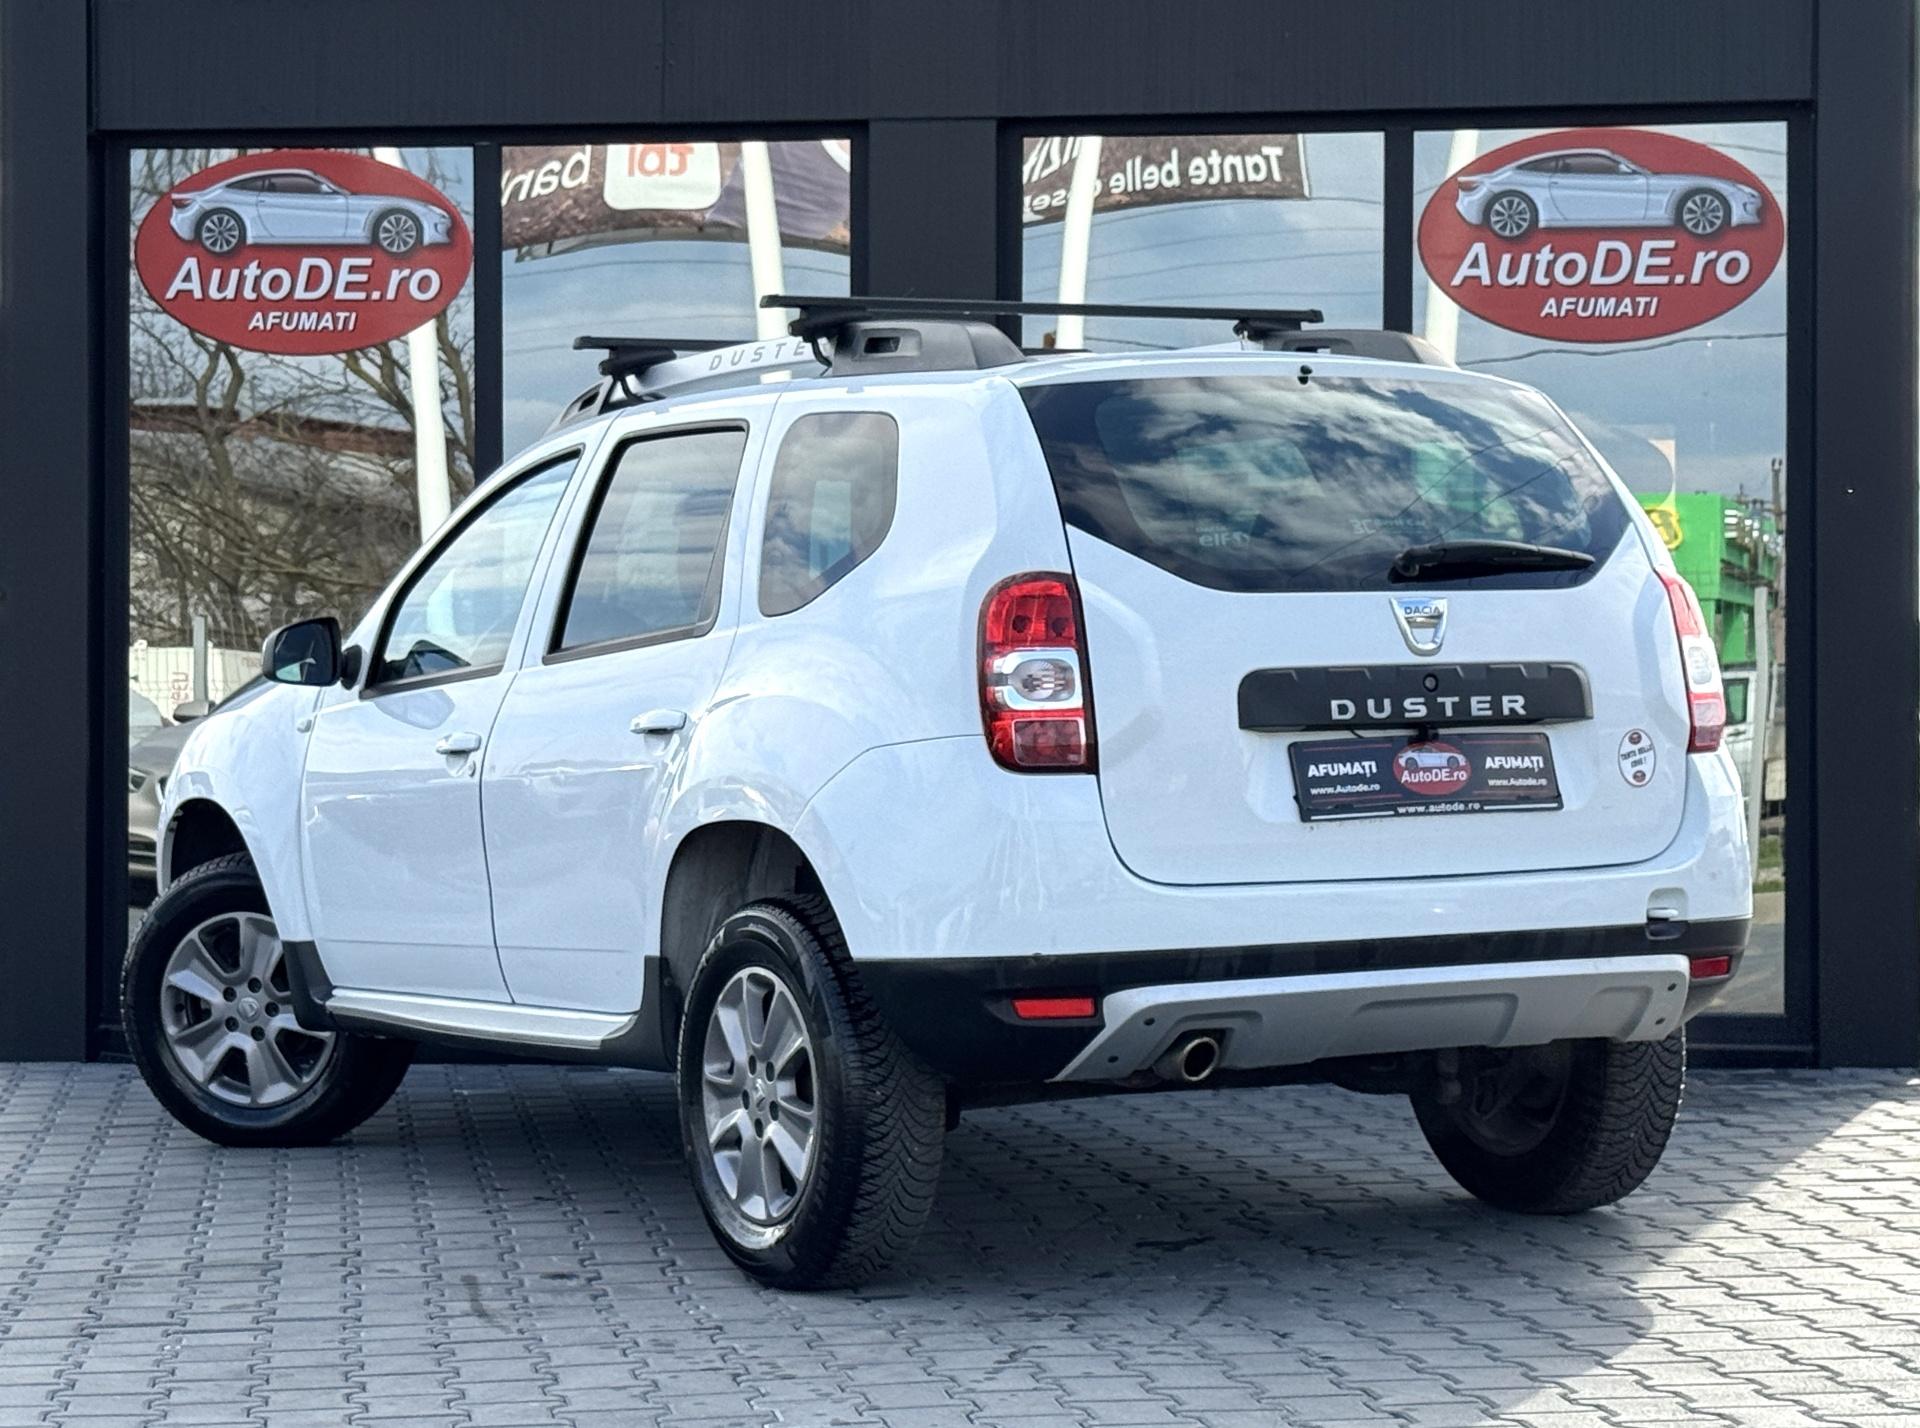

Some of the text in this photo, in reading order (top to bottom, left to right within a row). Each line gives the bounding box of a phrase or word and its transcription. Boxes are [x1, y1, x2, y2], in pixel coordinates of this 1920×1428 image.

[1450, 239, 1751, 287] AutoDE.ro
[165, 256, 442, 301] AutoDE.ro
[1540, 296, 1659, 318] AFUMATI
[248, 311, 357, 331] AFUMATI
[708, 340, 807, 371] DUSTE
[1404, 605, 1441, 615] DACIA
[1330, 694, 1527, 720] DUSTER
[1401, 768, 1467, 784] AutoDE.ro
[1397, 802, 1481, 814] www.autode.ro
